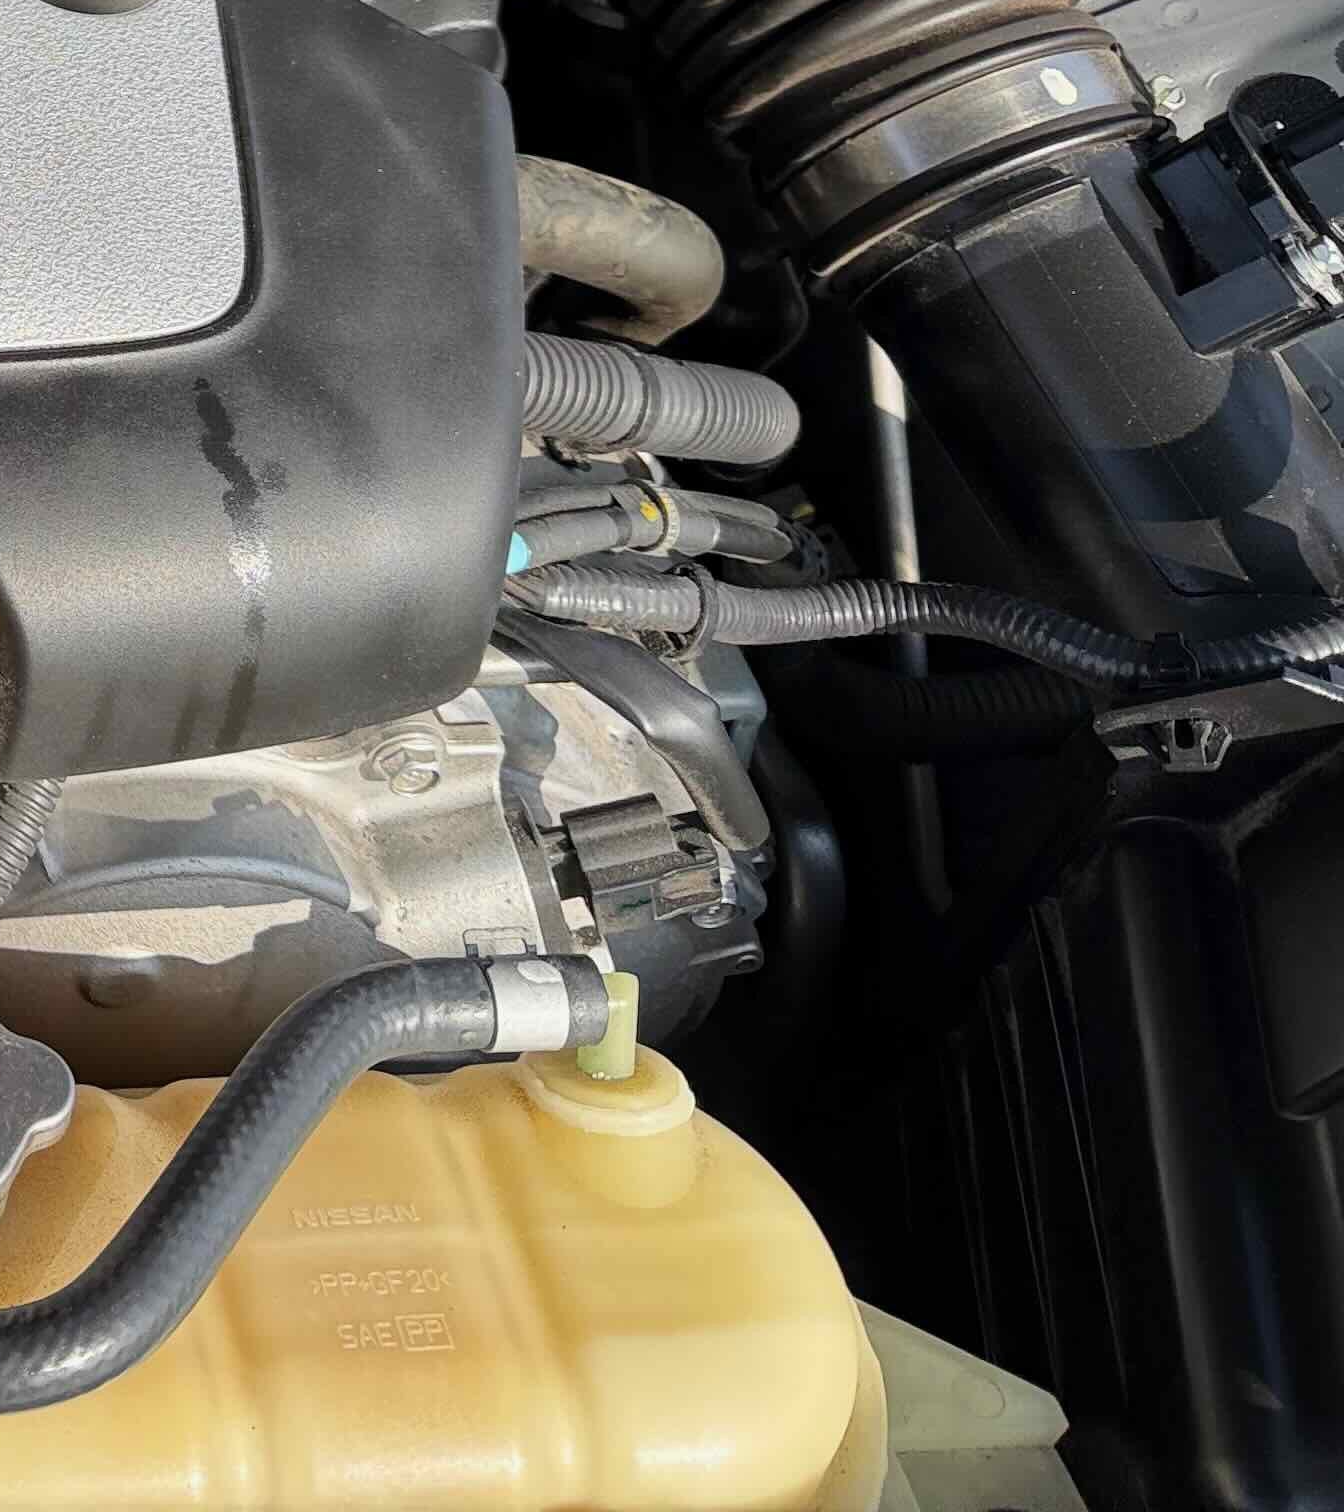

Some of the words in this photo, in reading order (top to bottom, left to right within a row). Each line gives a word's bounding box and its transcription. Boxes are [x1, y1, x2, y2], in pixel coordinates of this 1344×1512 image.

[291, 1203, 422, 1230] NISSAN
[336, 1321, 398, 1350] SAE
[404, 1319, 443, 1345] PP
